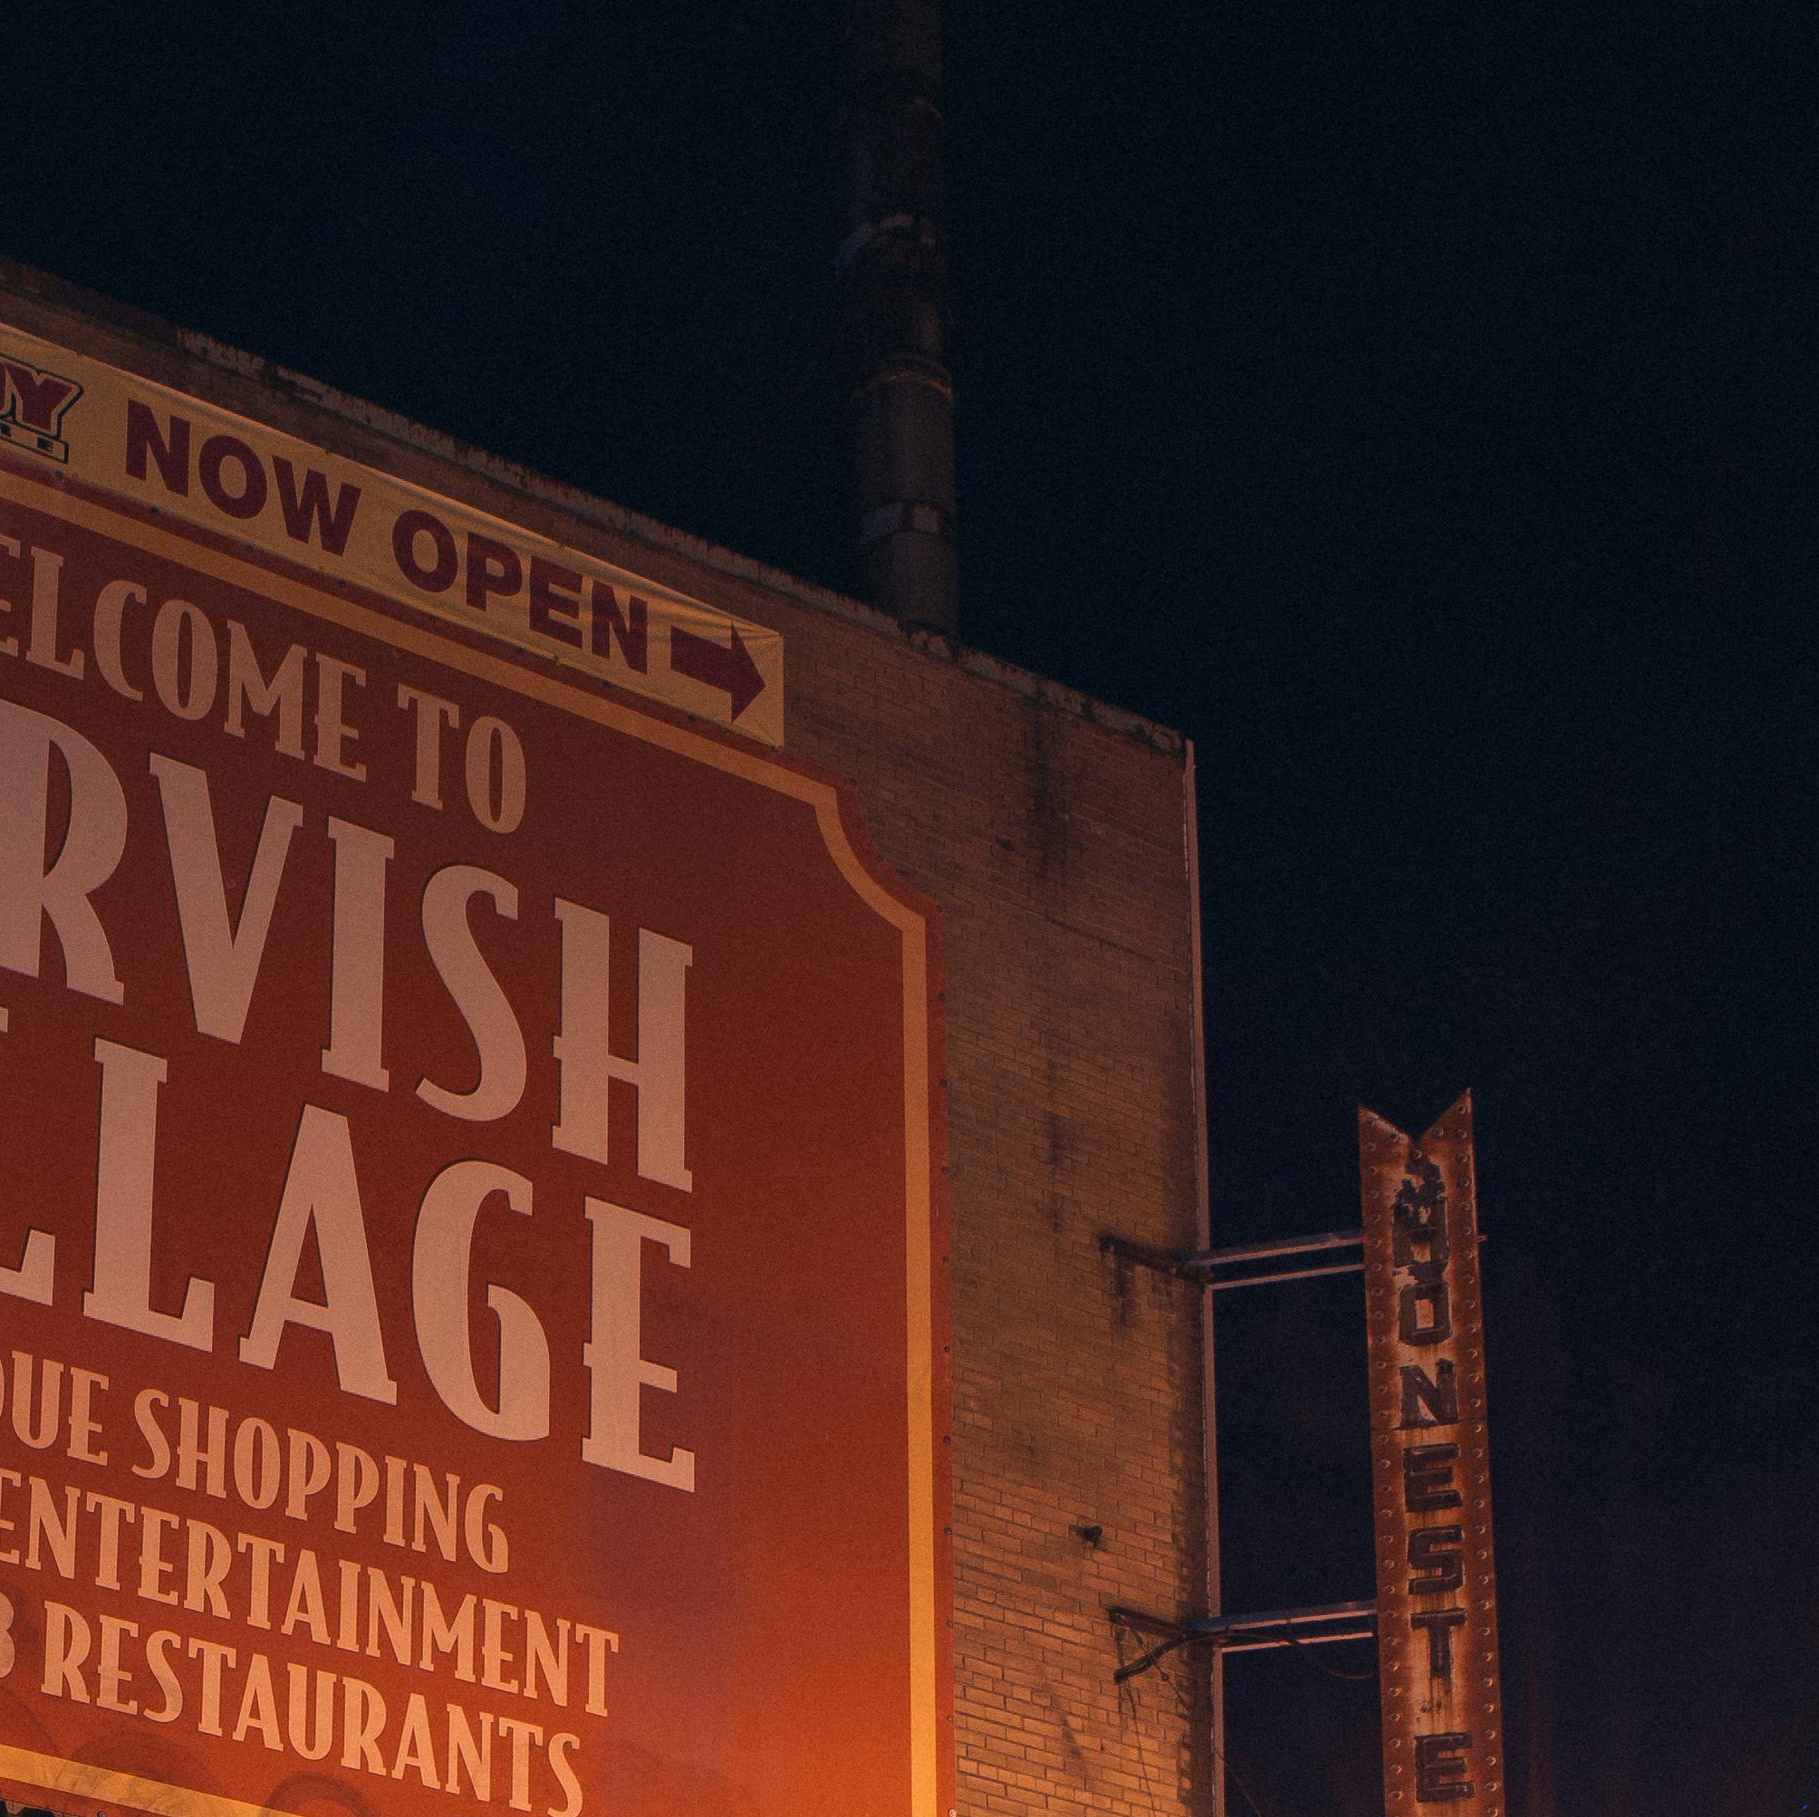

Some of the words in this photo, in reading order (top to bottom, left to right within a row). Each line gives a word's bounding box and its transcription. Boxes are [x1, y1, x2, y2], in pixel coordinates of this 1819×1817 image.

[125, 396, 362, 556] NOW
[391, 508, 649, 675] OPEN
[397, 685, 527, 835] TO
[130, 1387, 510, 1574] SHOPPING
[1392, 1198, 1467, 1680] HONEST
